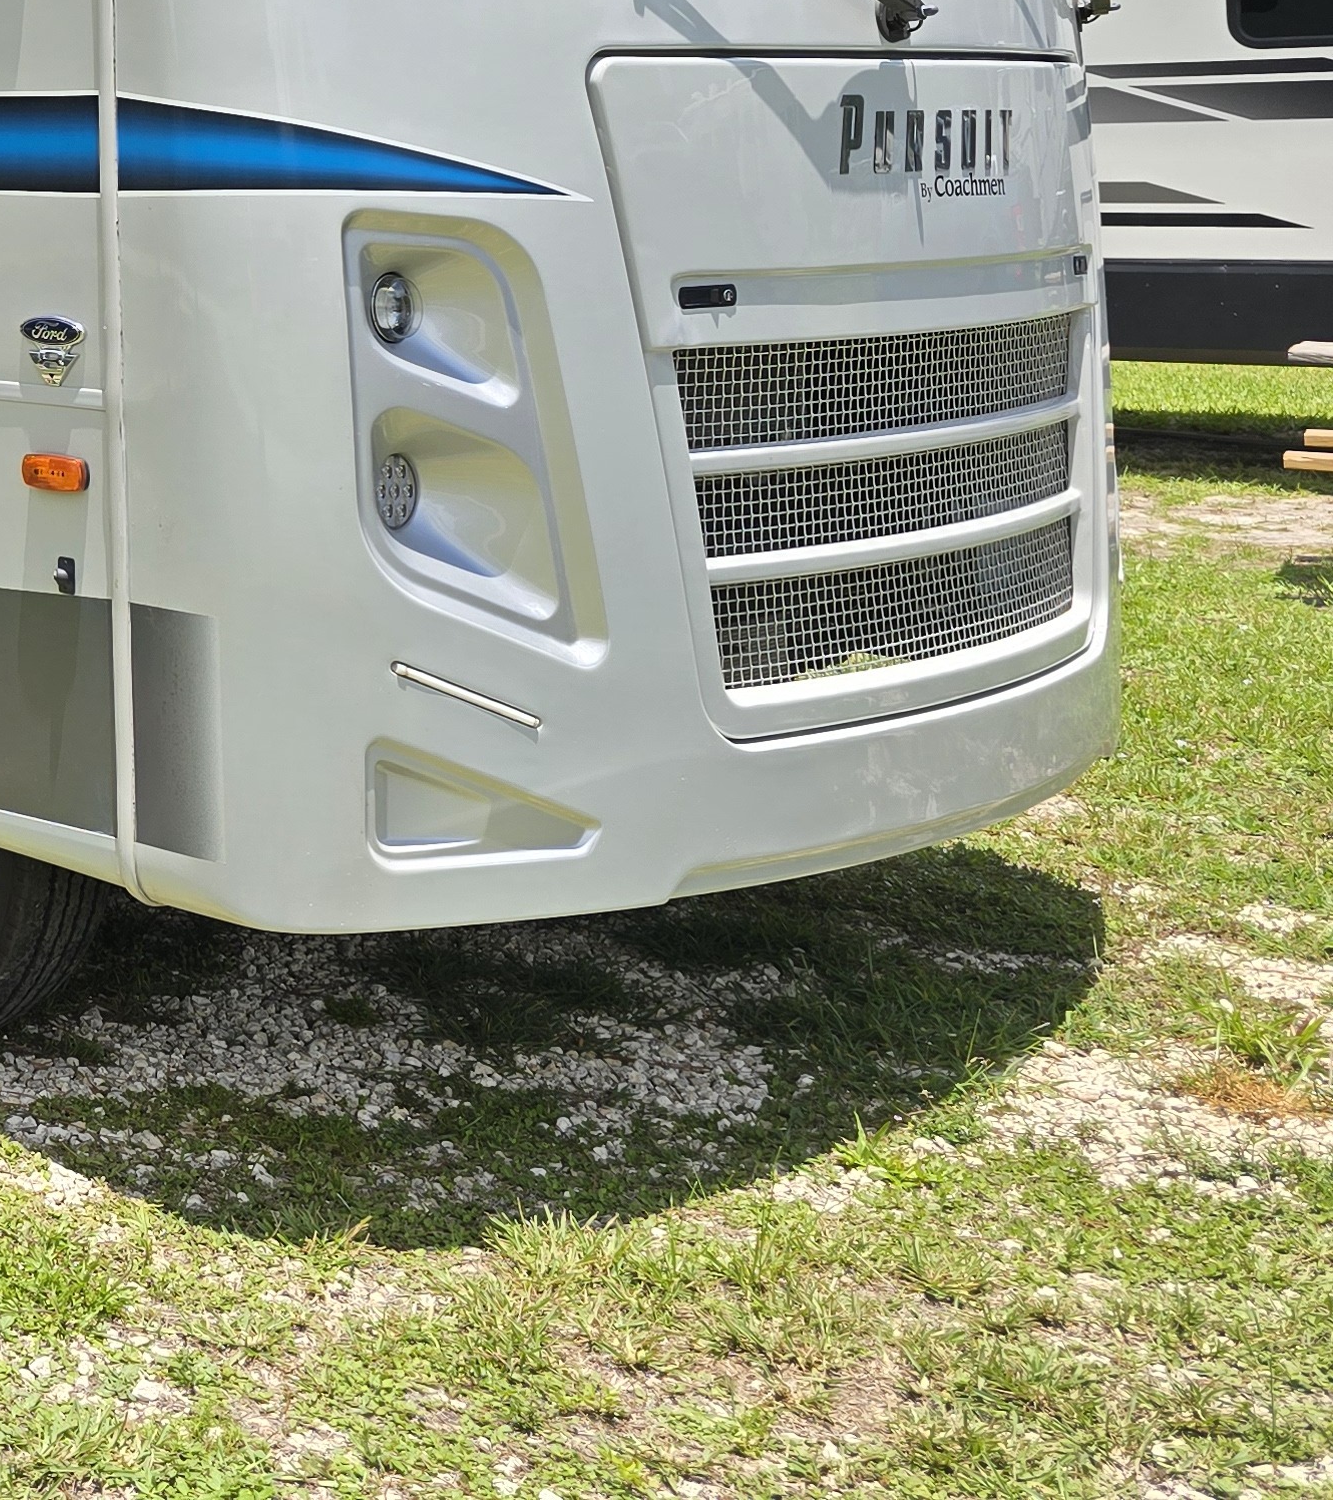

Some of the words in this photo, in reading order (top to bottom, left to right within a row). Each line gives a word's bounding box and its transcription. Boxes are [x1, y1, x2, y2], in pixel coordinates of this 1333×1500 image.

[839, 94, 1012, 174] PURSUIT
[920, 182, 933, 203] By
[934, 173, 1006, 198] Coachmen
[31, 321, 68, 341] Ford
